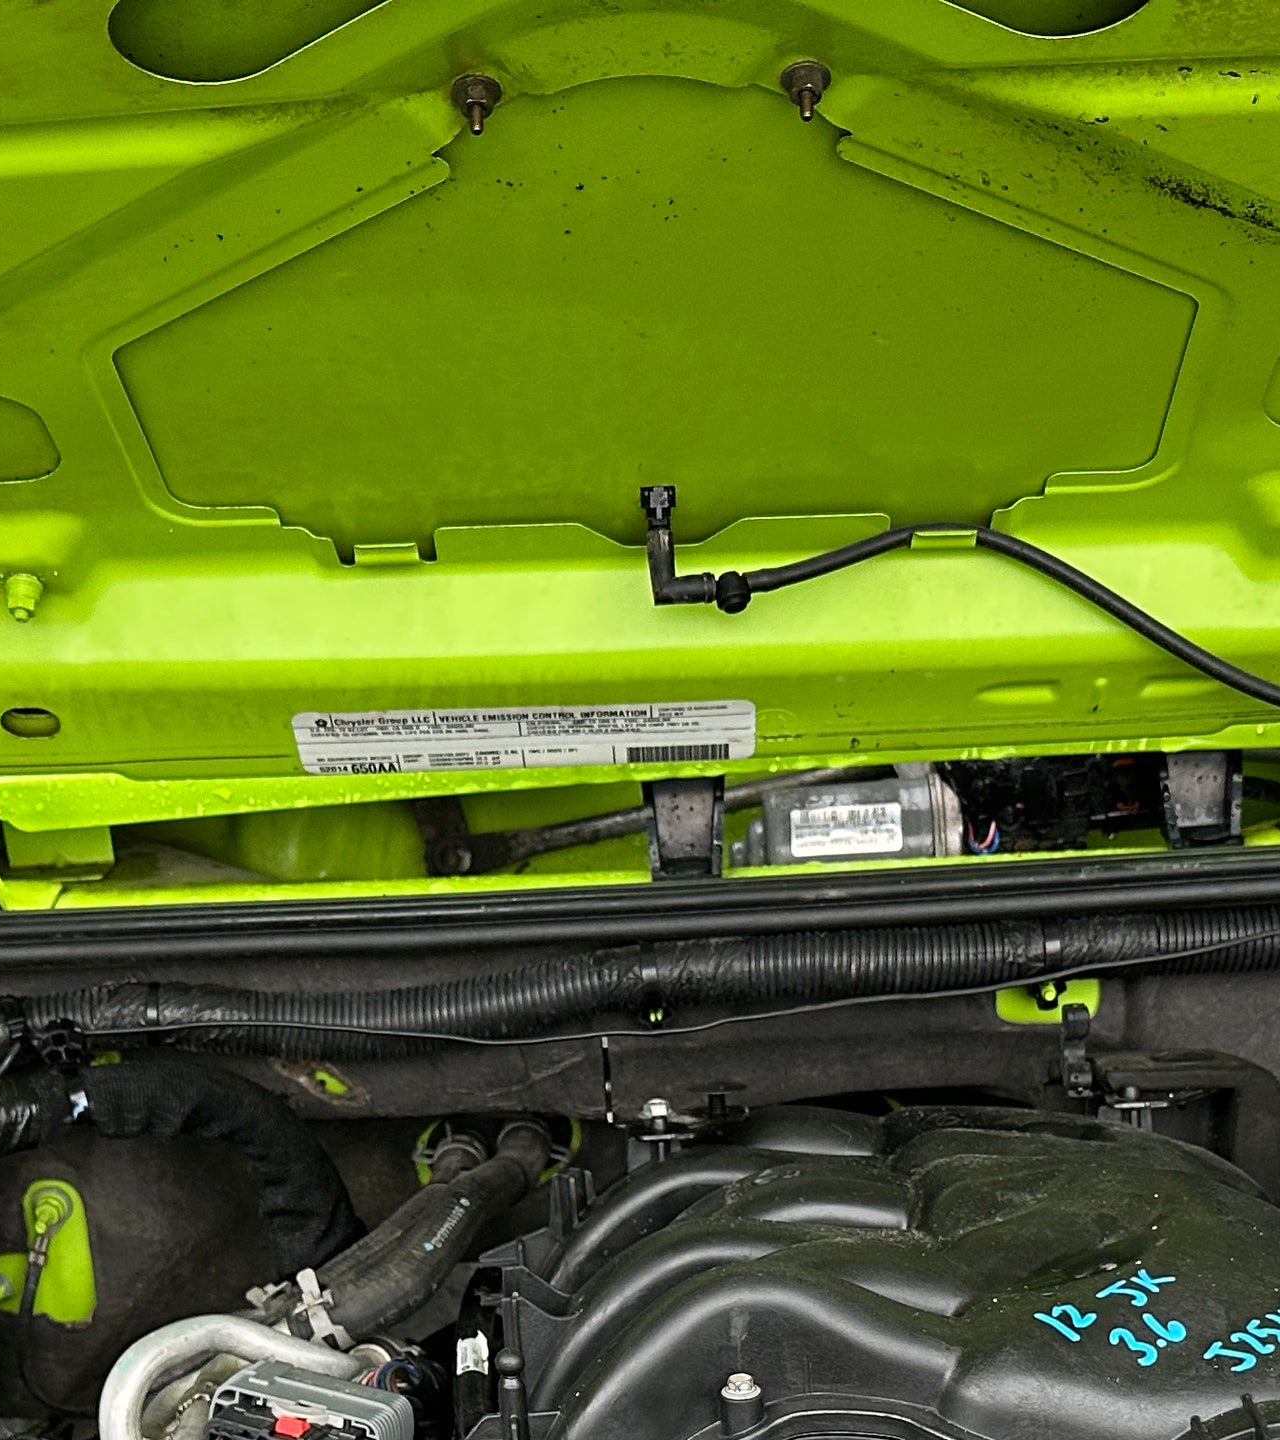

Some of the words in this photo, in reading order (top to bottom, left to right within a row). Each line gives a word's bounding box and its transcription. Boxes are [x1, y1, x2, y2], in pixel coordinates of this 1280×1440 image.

[334, 718, 375, 728] Chrysler
[378, 716, 408, 727] Group
[411, 715, 431, 724] LLC
[438, 714, 478, 723] VEHICLE
[482, 712, 529, 721] EMISSION
[532, 711, 576, 720] CONTROL
[580, 709, 648, 718] INFORMATION
[1033, 1303, 1098, 1342] 12
[1095, 1268, 1177, 1308] JK
[1108, 1312, 1188, 1367] 3.6
